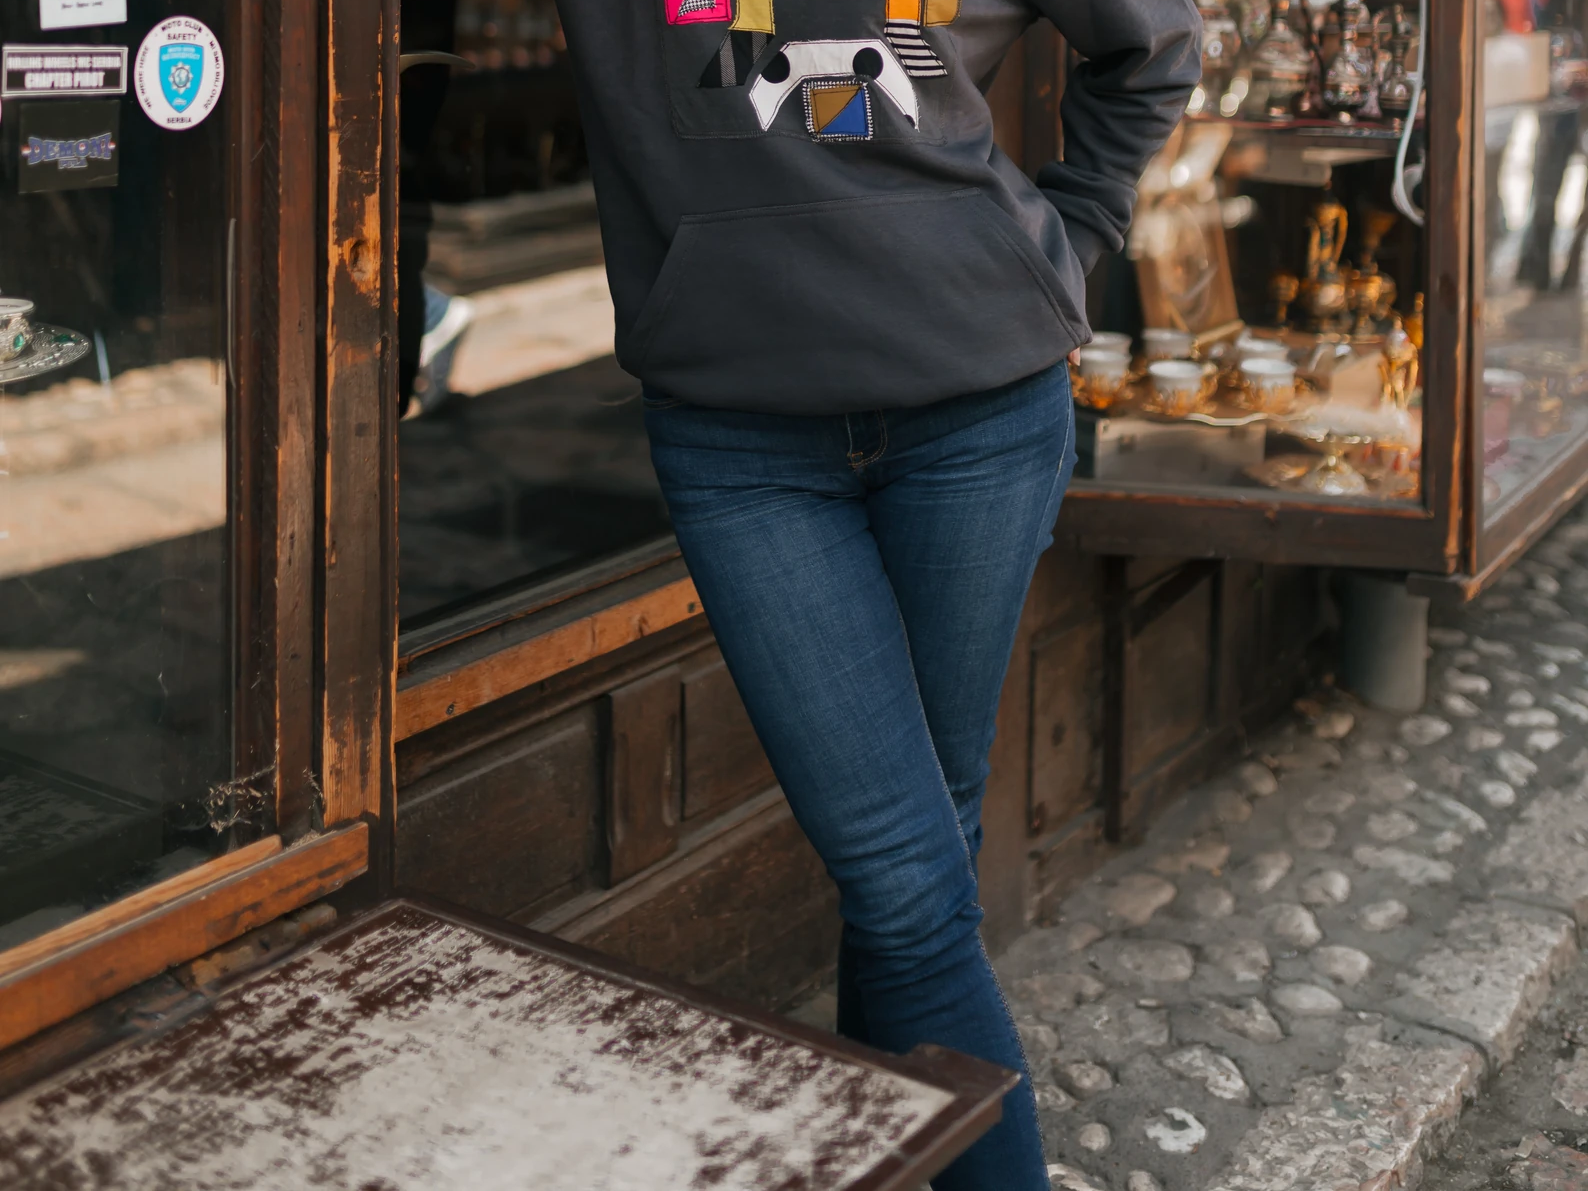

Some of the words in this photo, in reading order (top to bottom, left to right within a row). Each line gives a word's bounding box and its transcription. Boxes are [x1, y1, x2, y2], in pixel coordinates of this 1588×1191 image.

[161, 20, 182, 32] MOTO
[184, 20, 202, 34] CLUB
[167, 33, 197, 41] SAFETY
[167, 116, 192, 124] SERBIA
